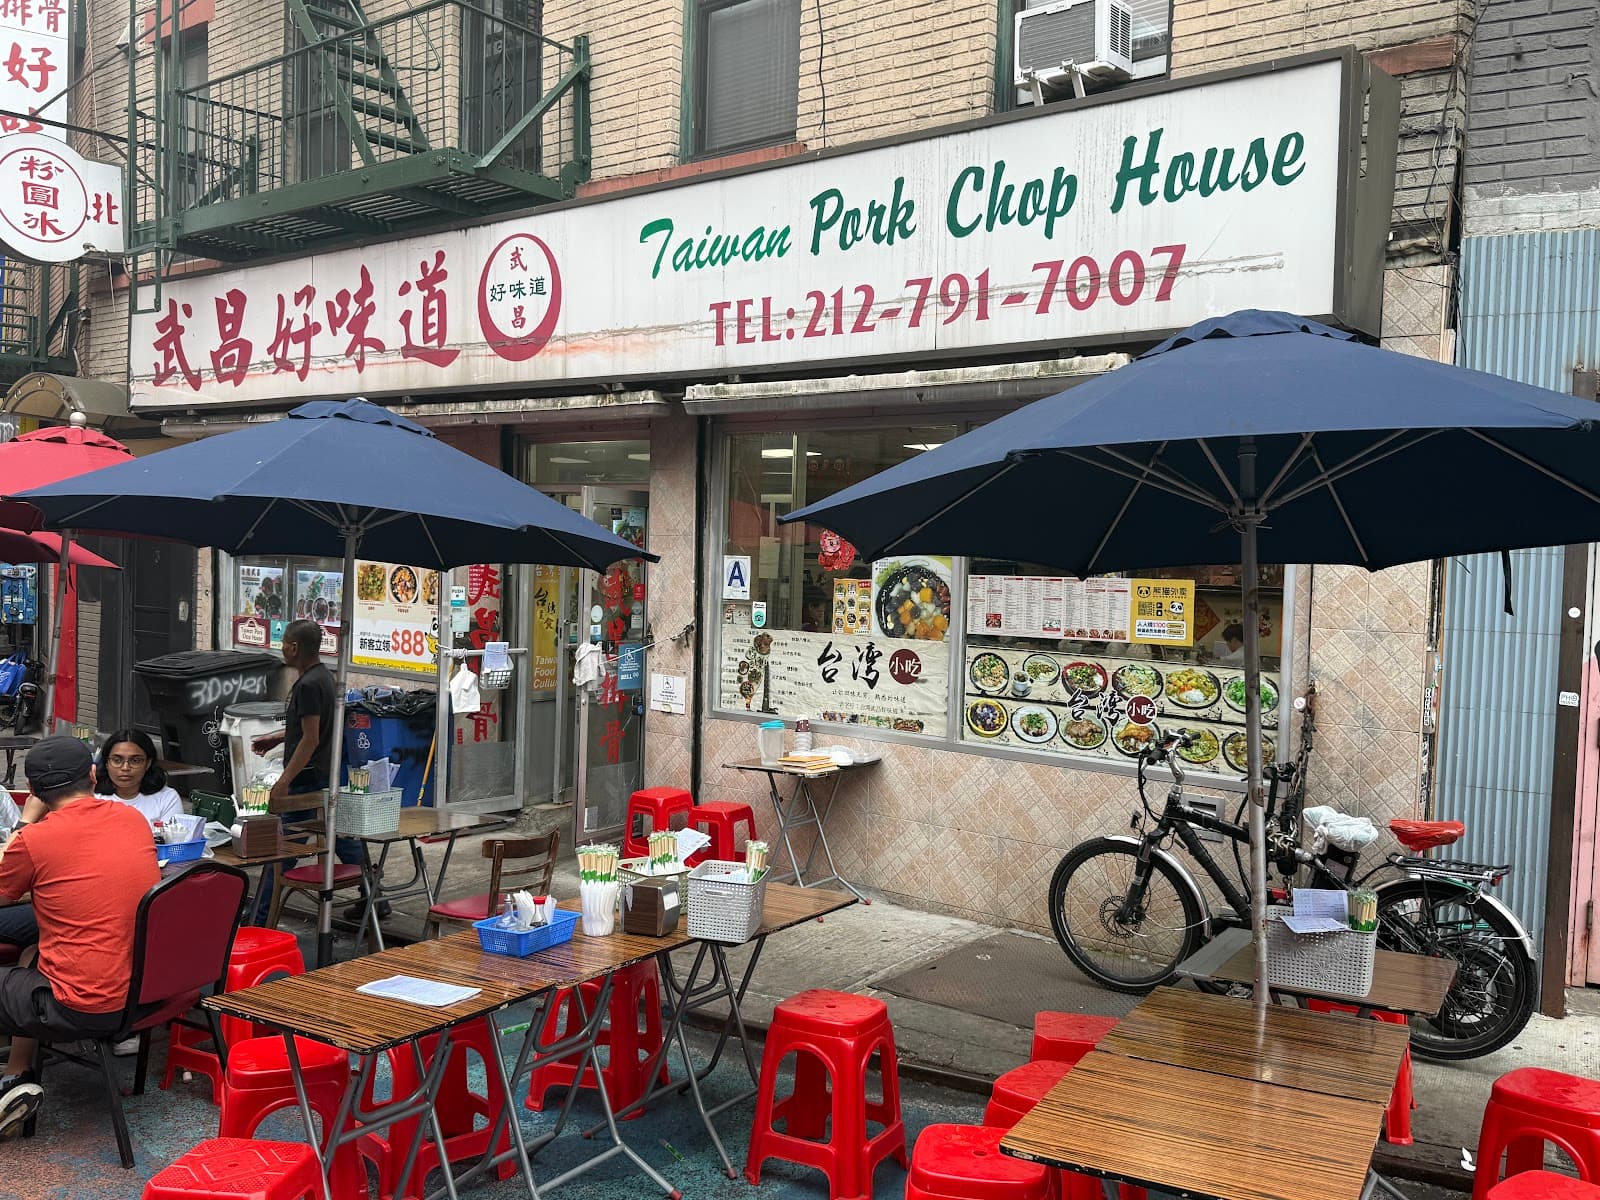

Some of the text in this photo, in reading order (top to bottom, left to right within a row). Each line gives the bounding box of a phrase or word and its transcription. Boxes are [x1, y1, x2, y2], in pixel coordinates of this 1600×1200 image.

[19, 155, 65, 237] 粉圓冰
[640, 126, 1307, 279] Taiwan Pork Chop House
[489, 275, 547, 302] 好味道
[153, 250, 461, 391] 武昌好味道
[511, 304, 526, 329] 昌
[727, 560, 746, 588] A
[391, 628, 425, 657] $88
[889, 656, 923, 678] 小吃
